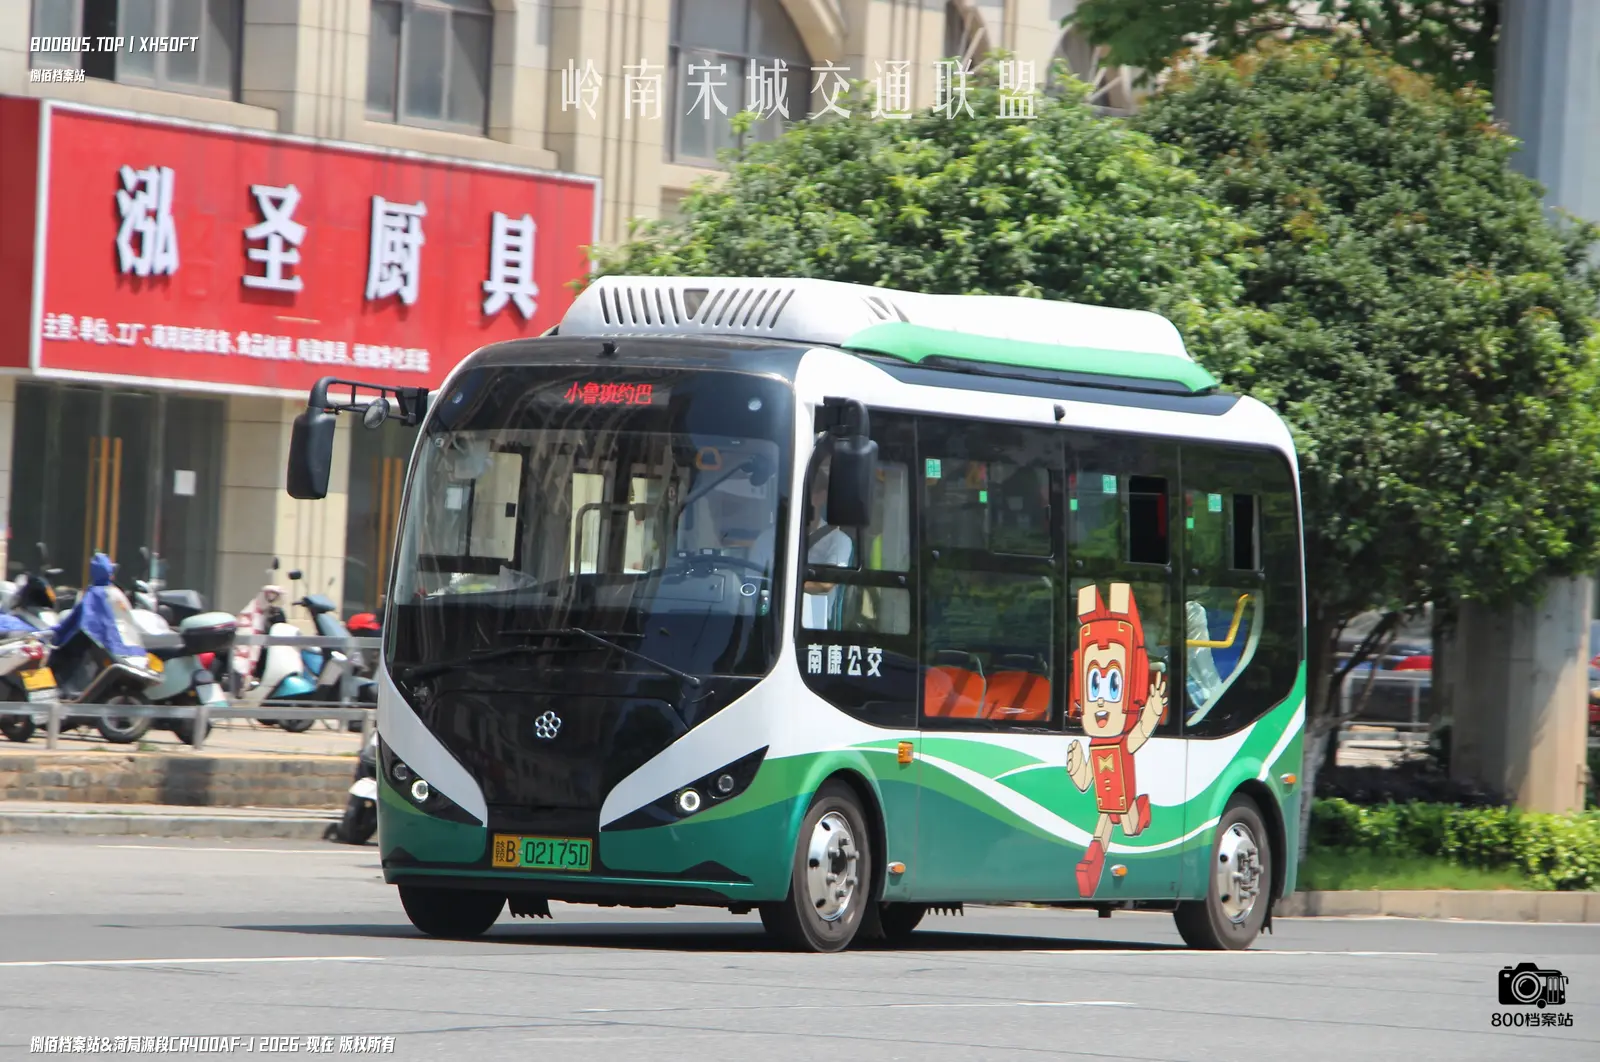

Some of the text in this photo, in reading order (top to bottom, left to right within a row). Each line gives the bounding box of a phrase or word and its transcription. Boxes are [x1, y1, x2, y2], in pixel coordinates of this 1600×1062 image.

[116, 164, 538, 320] 泓圣厨具
[563, 381, 653, 405] 小鲁班约巴
[807, 643, 883, 677] 南康公交
